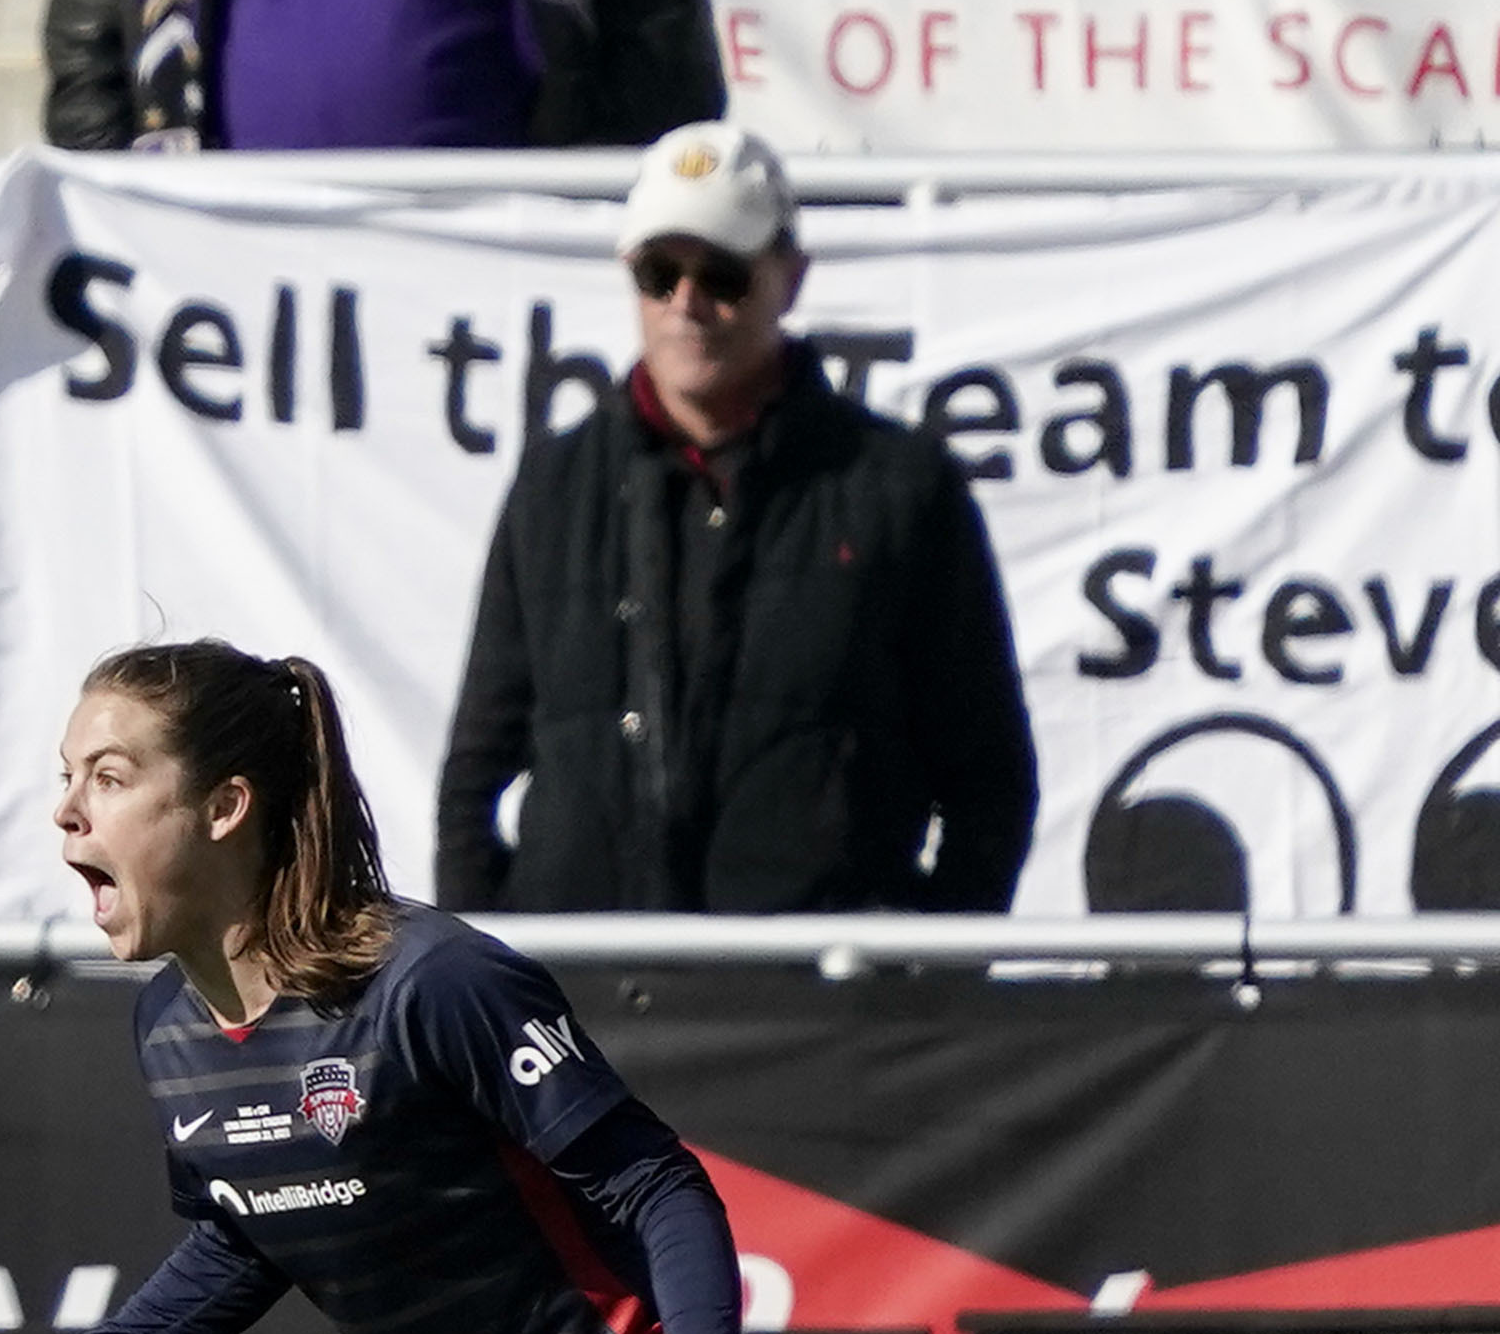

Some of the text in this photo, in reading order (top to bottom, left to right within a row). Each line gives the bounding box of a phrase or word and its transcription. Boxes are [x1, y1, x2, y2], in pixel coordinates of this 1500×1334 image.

[825, 9, 960, 97] OF
[1017, 9, 1216, 97] THE
[1267, 9, 1500, 101] SCA
[46, 252, 367, 433] Sell
[424, 300, 614, 457] th
[1394, 319, 1500, 463] t
[1077, 544, 1500, 685] Stev
[509, 1013, 586, 1086] ally
[308, 1088, 348, 1109] SPIRIT
[247, 1177, 368, 1215] IntelliBridge
